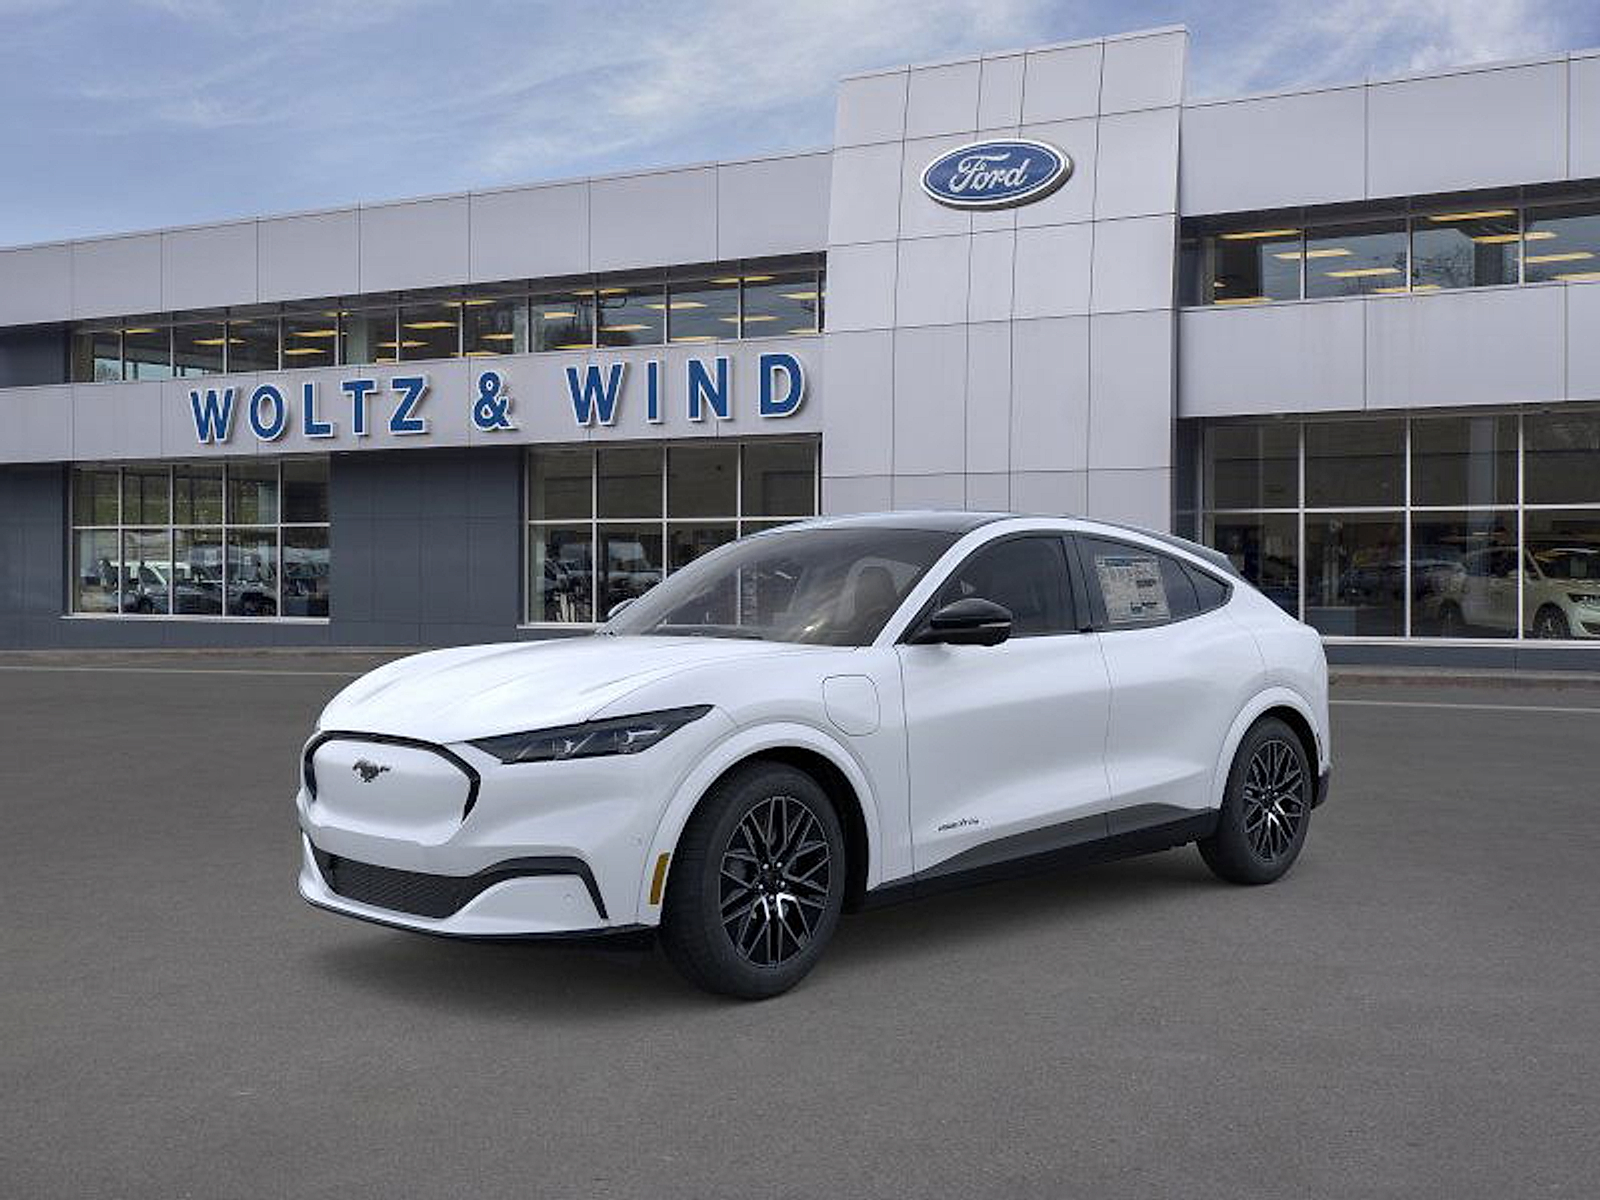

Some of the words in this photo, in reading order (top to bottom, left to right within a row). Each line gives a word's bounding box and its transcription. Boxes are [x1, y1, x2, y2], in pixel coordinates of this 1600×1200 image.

[949, 152, 1031, 193] Ford
[189, 374, 429, 443] WOLTZ
[472, 370, 516, 431] &
[564, 352, 806, 426] WIND
